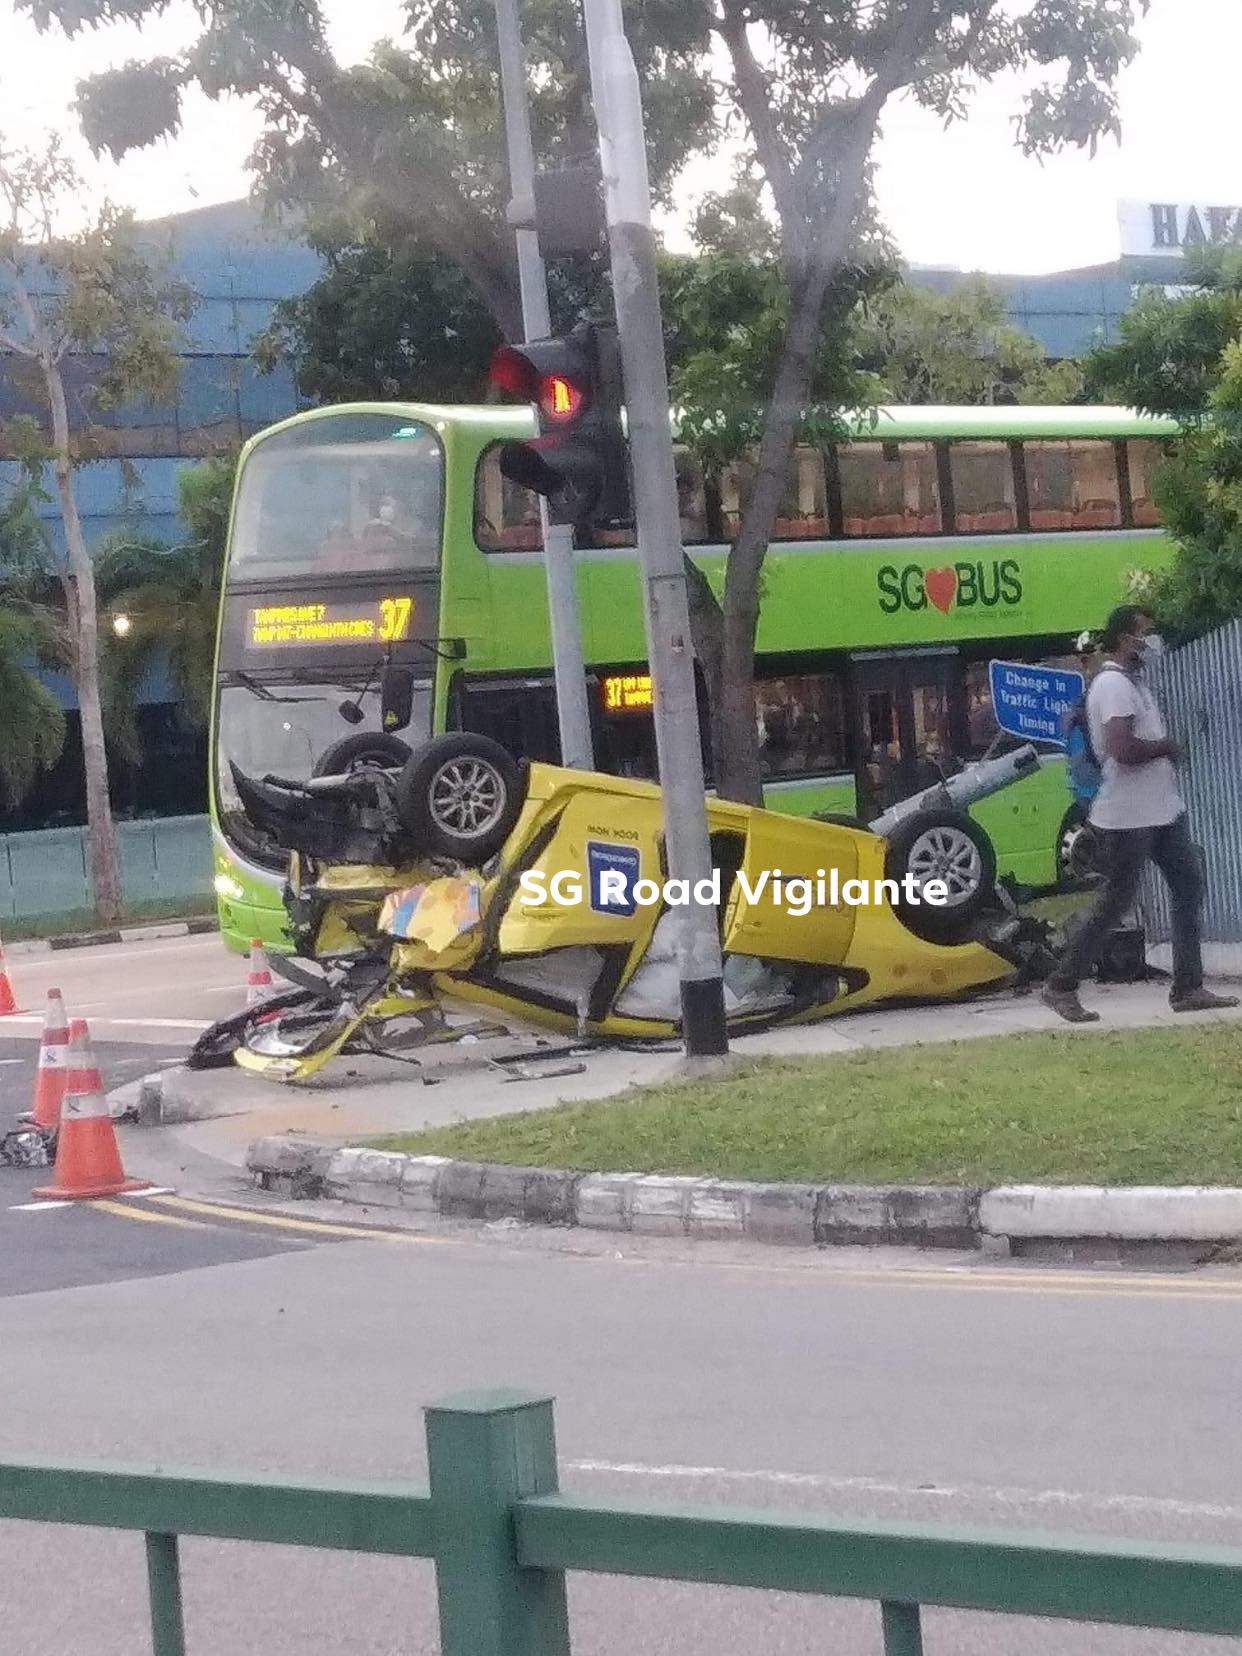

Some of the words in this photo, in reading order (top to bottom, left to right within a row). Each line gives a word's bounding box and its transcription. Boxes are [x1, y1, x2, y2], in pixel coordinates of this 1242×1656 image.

[877, 563, 928, 613] SG
[955, 559, 1022, 607] BUS
[379, 598, 412, 640] 37
[605, 677, 621, 707] 37
[1005, 670, 1049, 694] Change
[1055, 679, 1066, 693] in
[1001, 688, 1038, 709] Traffic
[1043, 696, 1070, 715] Ligh
[1018, 713, 1055, 735] Timing
